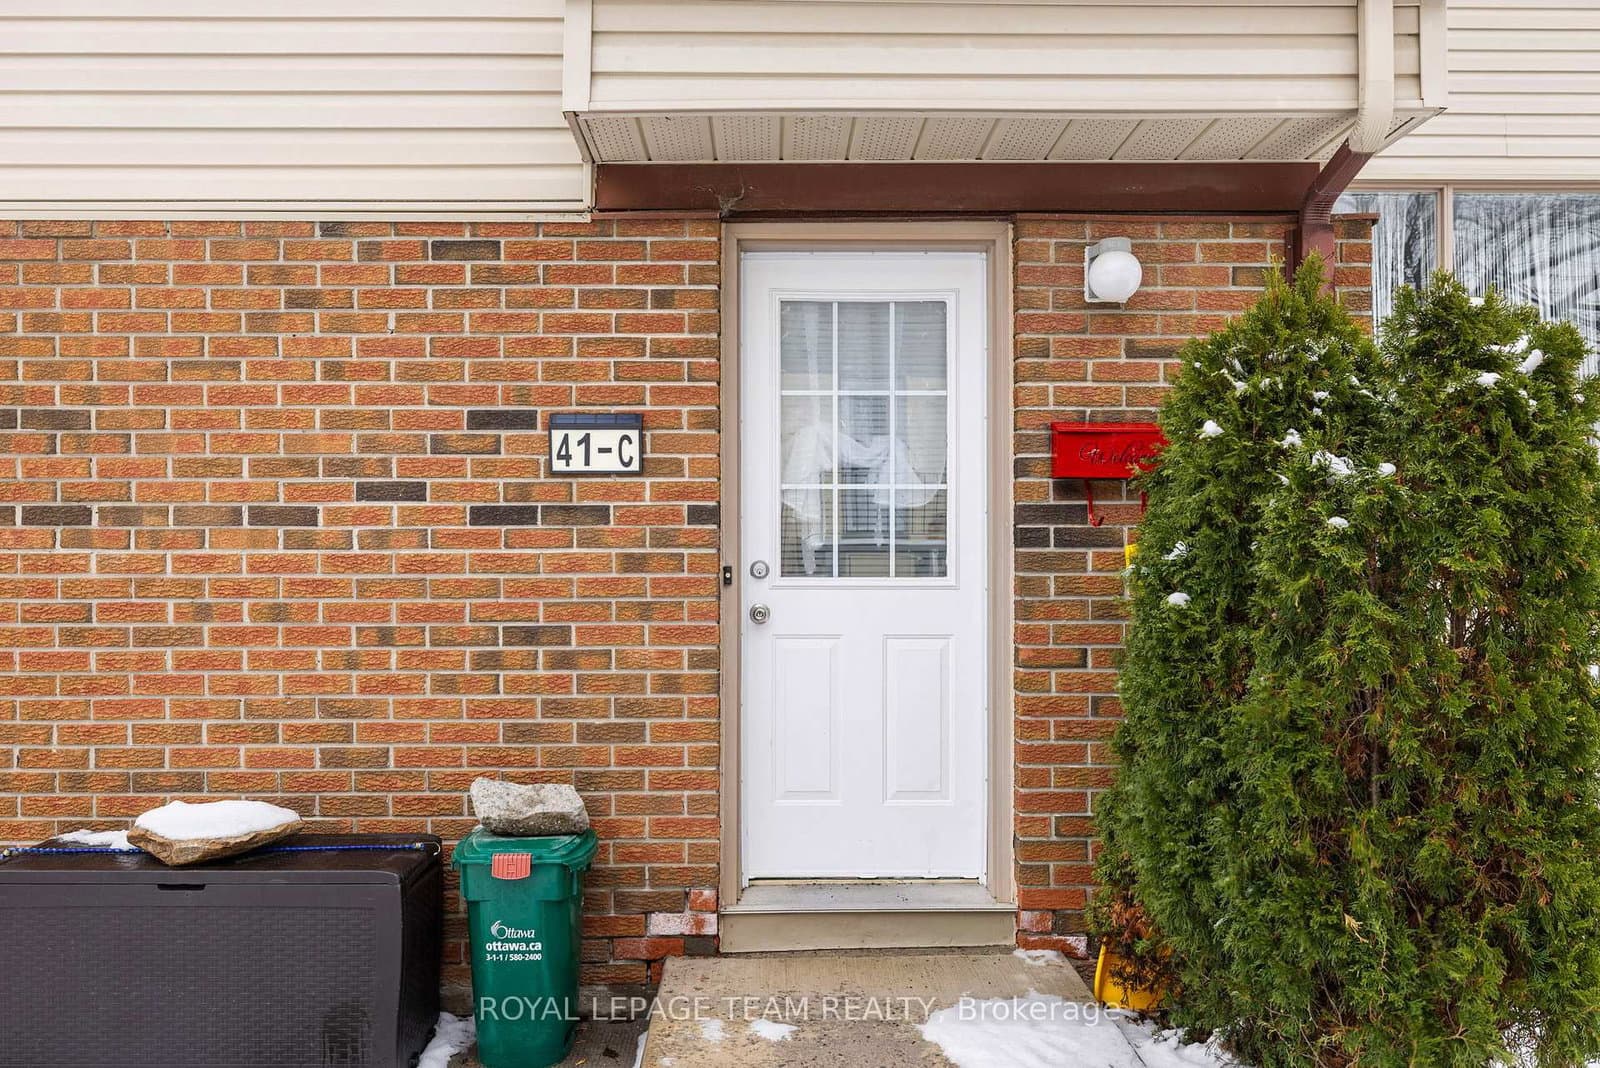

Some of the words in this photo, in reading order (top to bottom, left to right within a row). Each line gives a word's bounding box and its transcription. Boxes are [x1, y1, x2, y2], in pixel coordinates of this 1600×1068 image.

[556, 432, 634, 468] 41-C
[490, 920, 535, 939] Ottawa
[485, 941, 542, 951] ottawa.ca
[485, 953, 503, 961] 3-1-1
[509, 953, 542, 961] 580-2400
